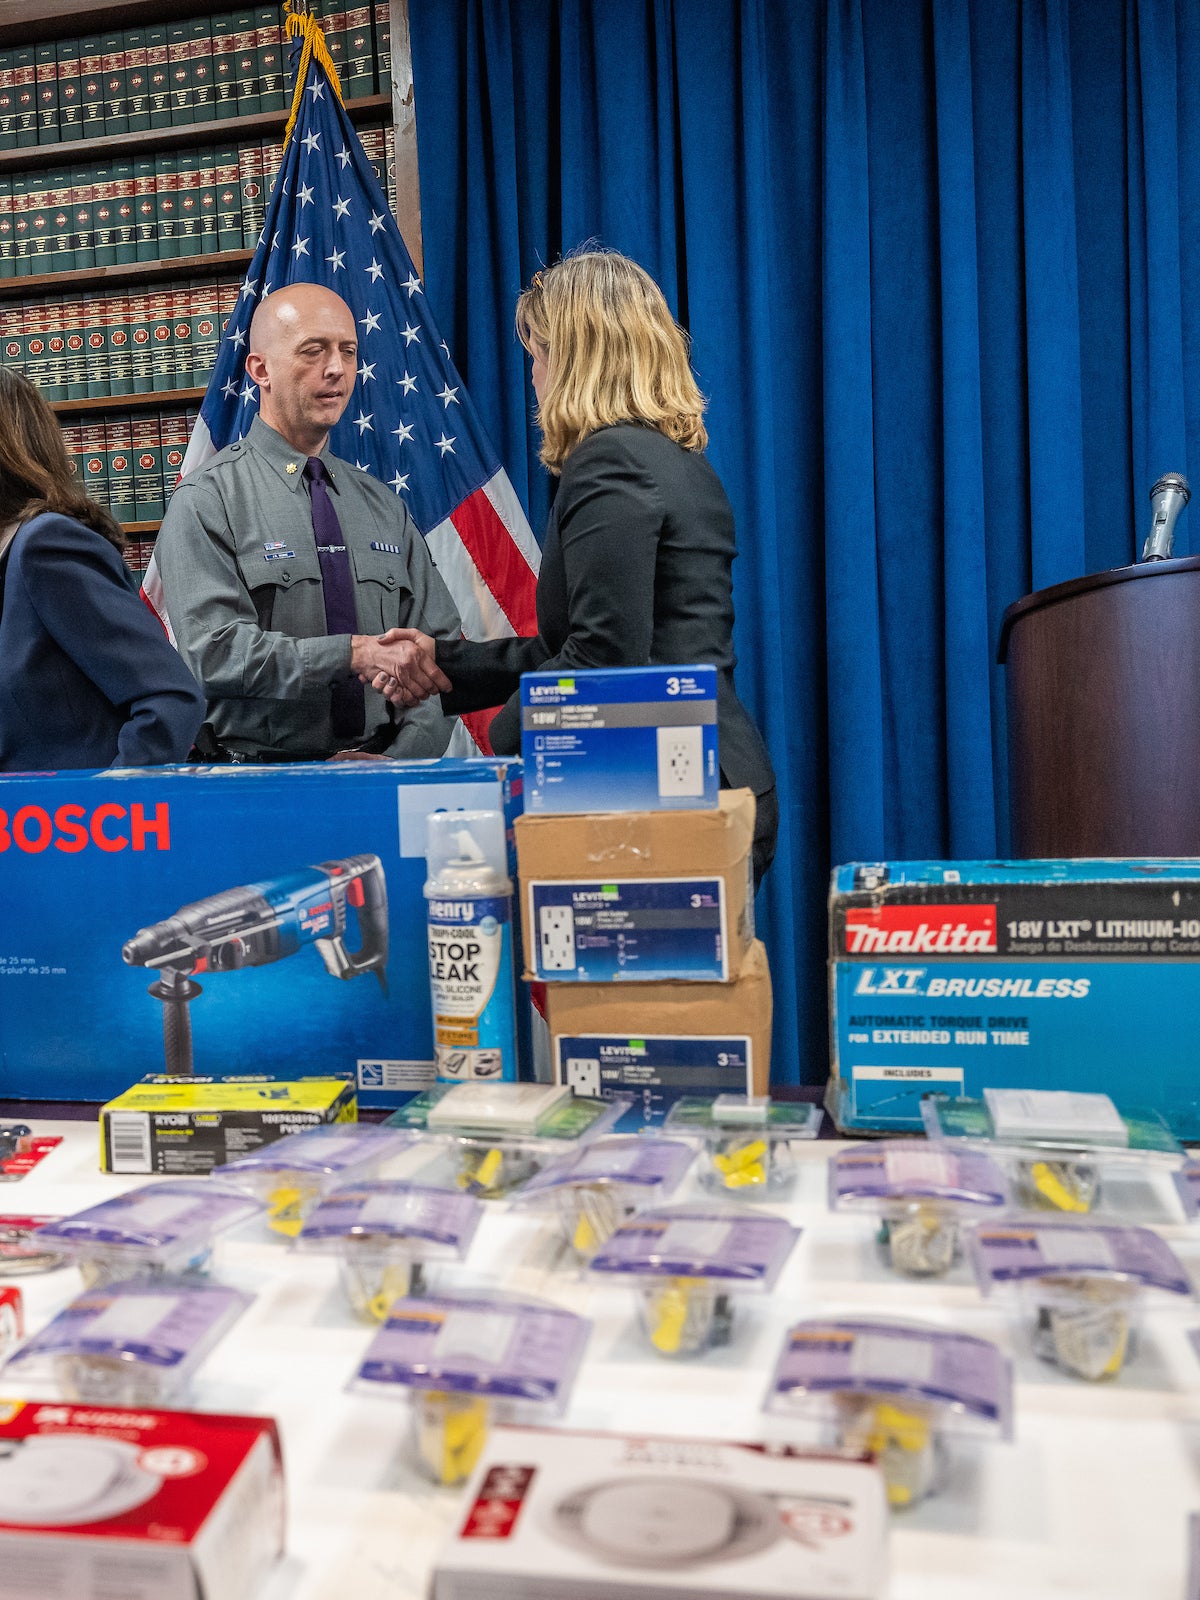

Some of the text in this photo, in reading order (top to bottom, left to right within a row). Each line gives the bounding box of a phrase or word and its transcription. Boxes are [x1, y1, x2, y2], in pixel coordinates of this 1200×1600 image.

[530, 686, 577, 697] LEVITON
[667, 677, 680, 695] 3
[691, 894, 702, 908] 3
[846, 920, 998, 952] Makita
[1007, 920, 1044, 938] 18V
[1096, 920, 1200, 938] LITHIUM-IO
[430, 943, 480, 961] STOP
[855, 968, 1091, 998] LXT BRUSHLESS
[849, 1016, 1029, 1029] AUTOMATIC TORQUE DRIVE
[872, 1030, 950, 1044] EXTENDED
[955, 1032, 987, 1045] RUN
[991, 1032, 1030, 1045] TIME
[718, 1052, 729, 1066] 3
[884, 1070, 932, 1078] INCLUDES
[155, 1114, 190, 1126] RYOBI
